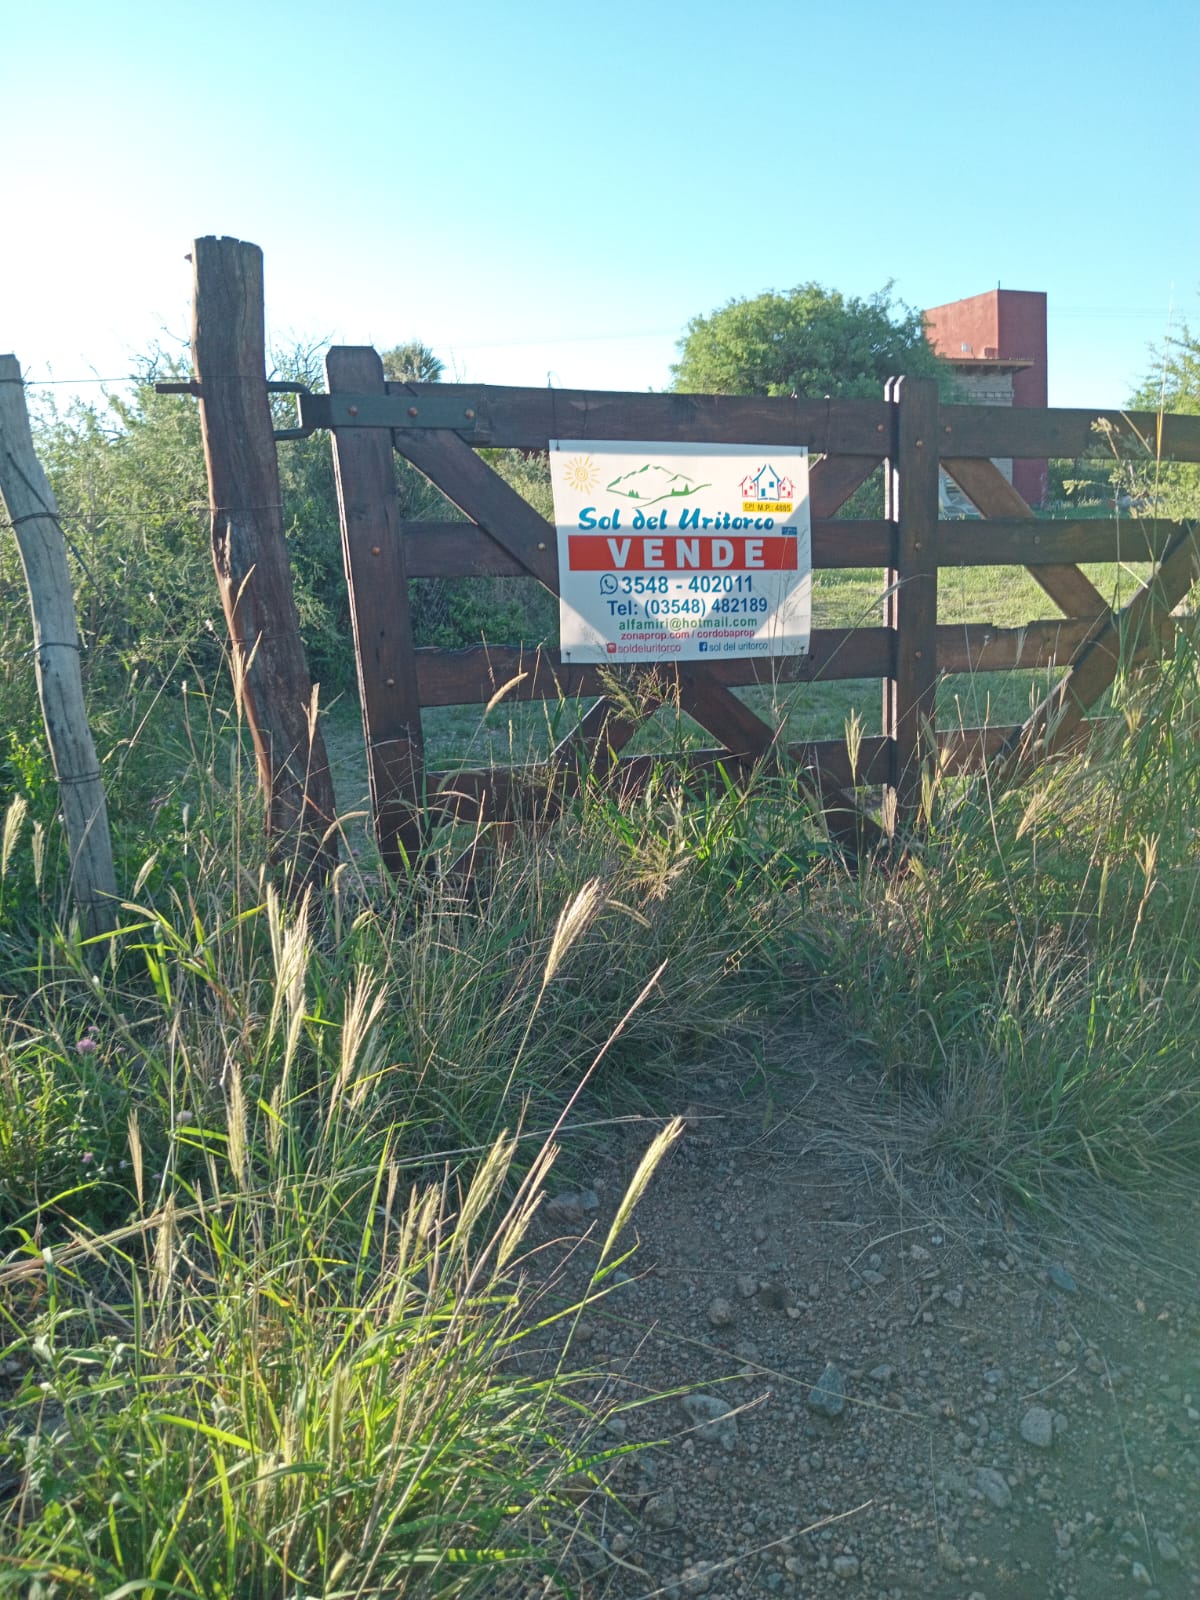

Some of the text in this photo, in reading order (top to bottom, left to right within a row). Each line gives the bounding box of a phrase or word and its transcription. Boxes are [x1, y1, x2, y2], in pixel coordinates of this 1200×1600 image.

[578, 507, 775, 530] Sol del Uritorco
[606, 537, 766, 569] VENDE
[621, 575, 669, 594] 3548
[688, 575, 753, 593] 402011
[607, 597, 768, 618] Tel: (03548) 482189
[618, 616, 758, 631] alfamiri@hotmail.com
[620, 629, 690, 641] zonaprop.com
[697, 629, 756, 640] cordobaprop
[709, 642, 721, 652] sol
[723, 642, 736, 651] del
